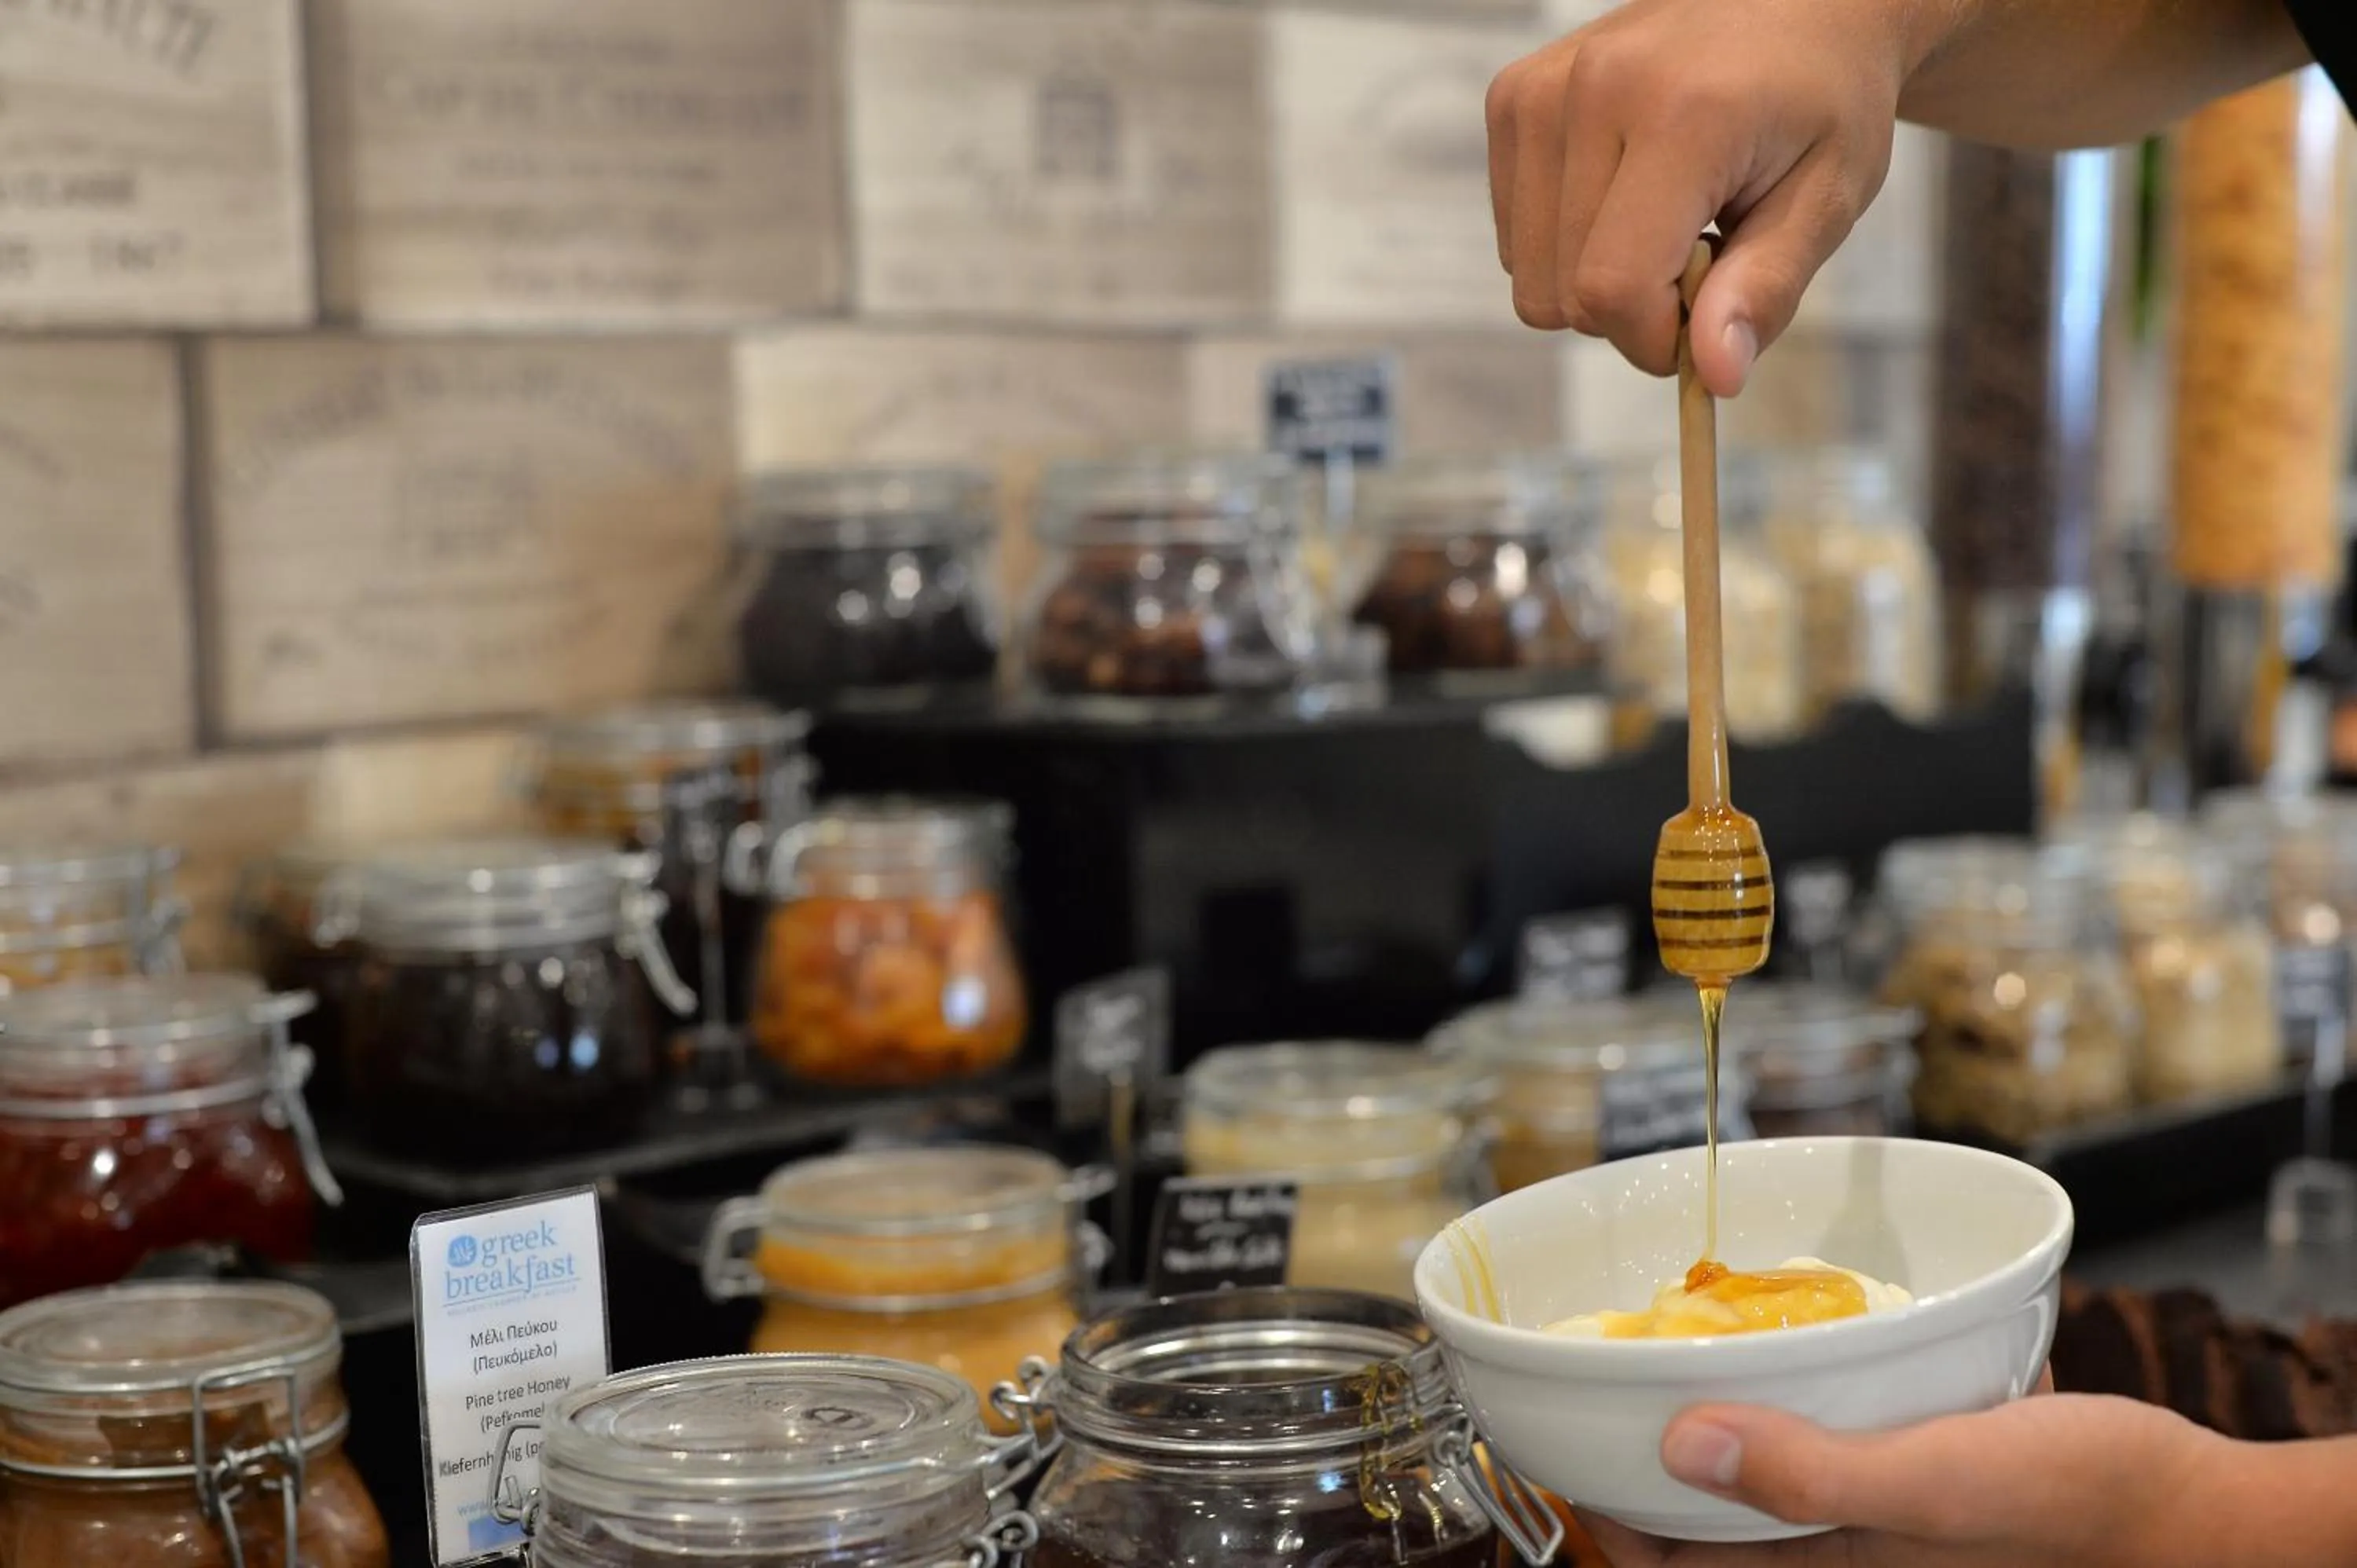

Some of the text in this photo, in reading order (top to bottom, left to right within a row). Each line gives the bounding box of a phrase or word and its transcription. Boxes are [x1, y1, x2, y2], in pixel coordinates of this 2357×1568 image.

[482, 1220, 558, 1267] greek
[445, 1253, 575, 1299] breakfast
[470, 1319, 558, 1349] Μέλι Πεύκου
[473, 1340, 558, 1375] (Πευκόμελο)
[466, 1376, 570, 1411] Pine tree Honey
[481, 1402, 545, 1433] (Pefkomel
[439, 1447, 522, 1477] Kiefernhnig
